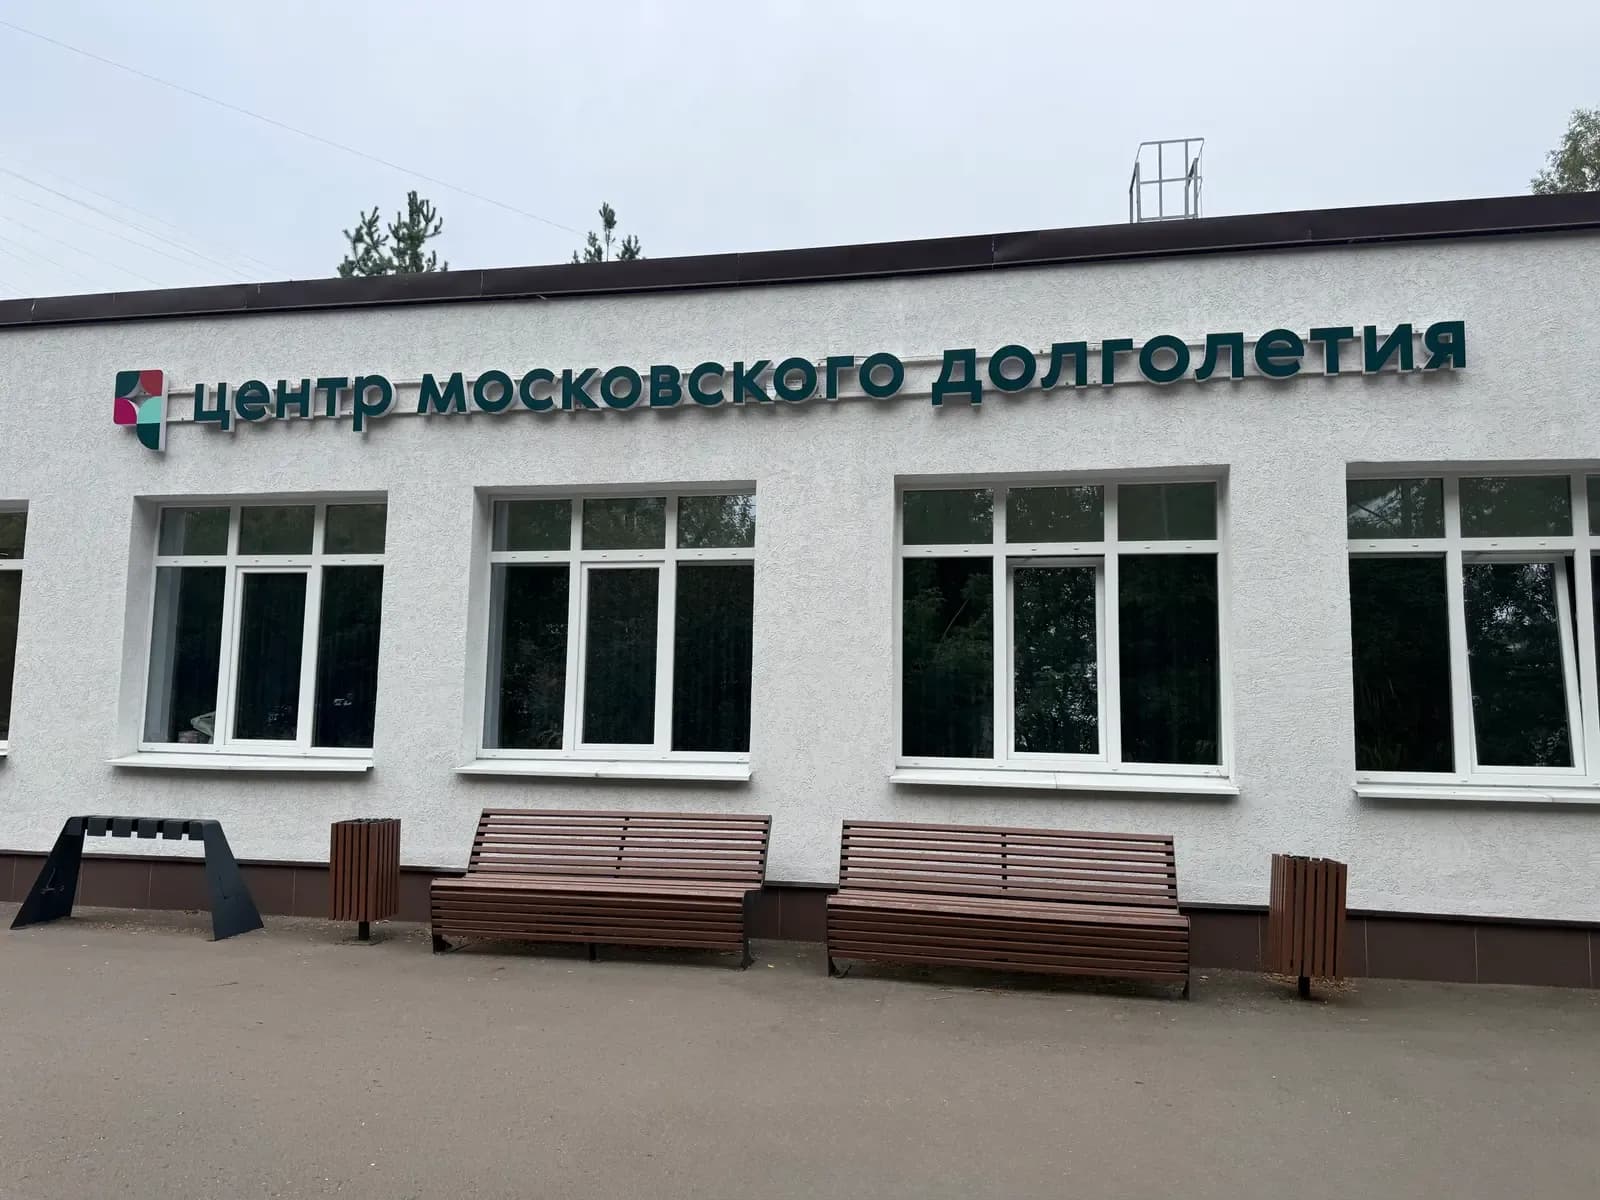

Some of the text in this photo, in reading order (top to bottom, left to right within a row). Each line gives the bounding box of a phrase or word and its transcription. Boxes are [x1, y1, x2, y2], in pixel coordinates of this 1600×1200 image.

[193, 321, 1466, 432] центр московского долголетия
